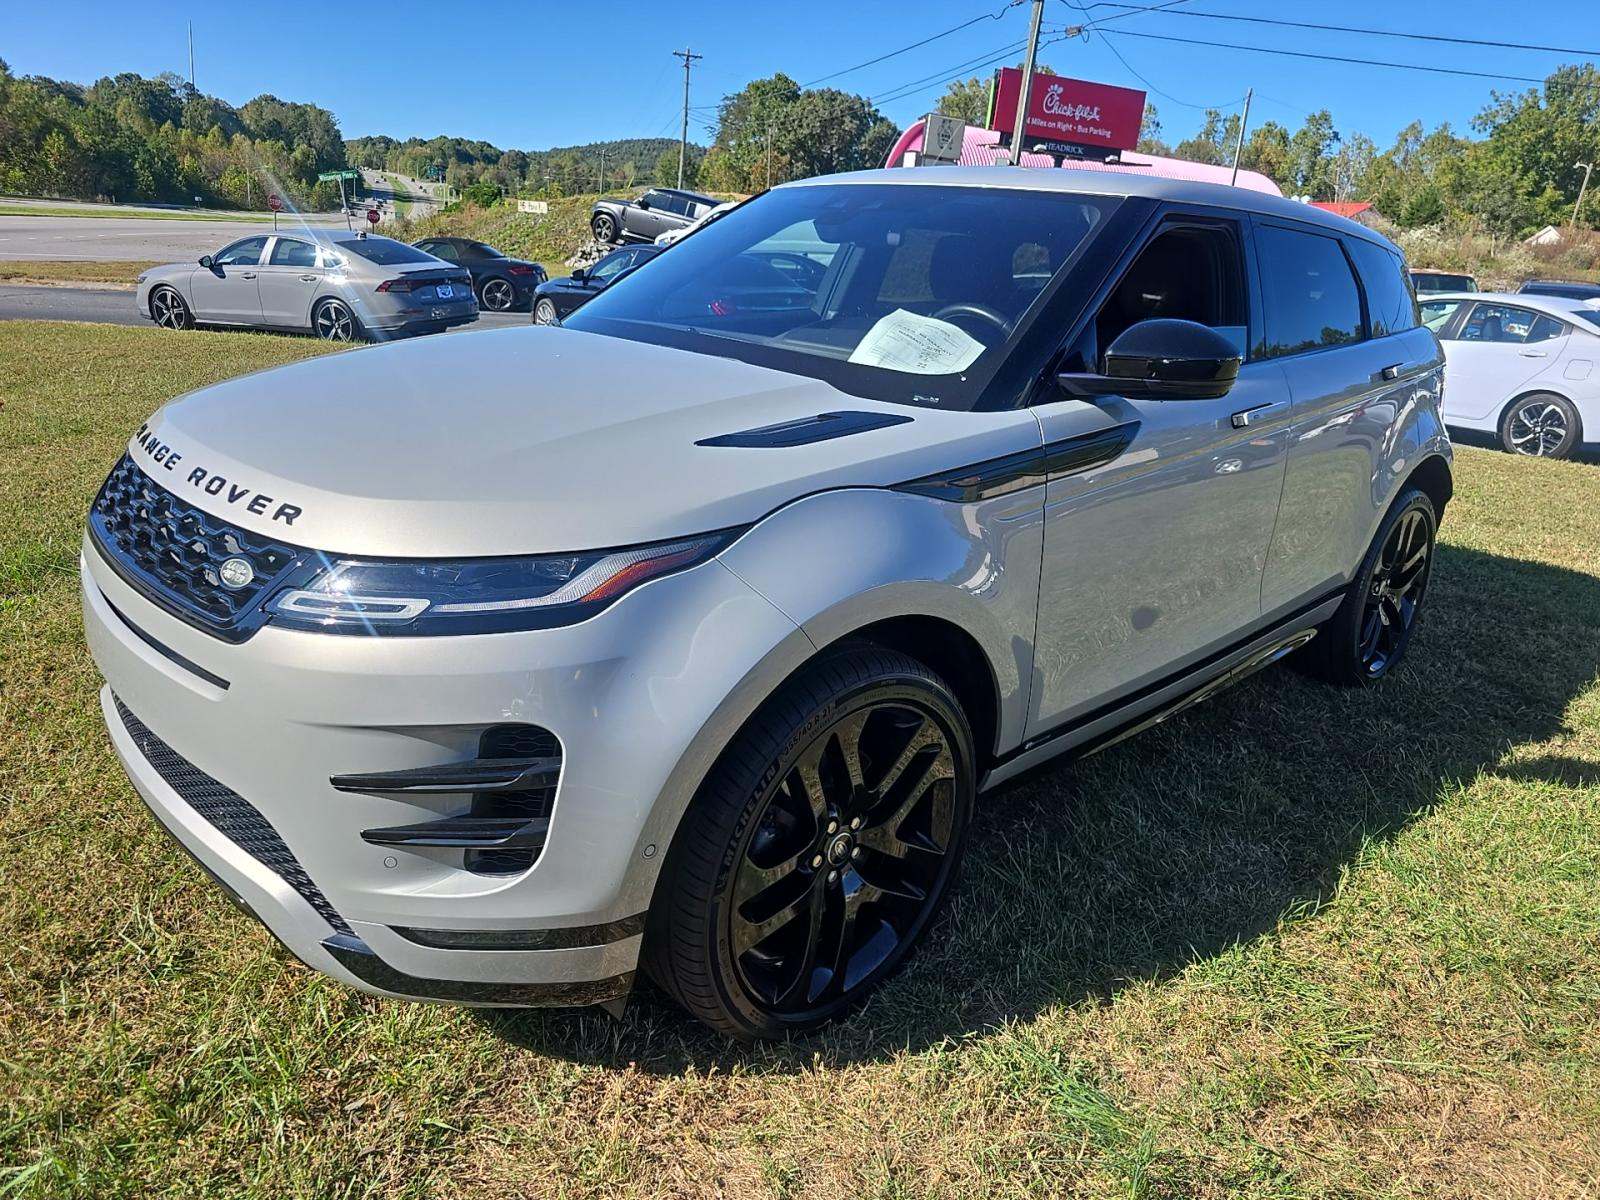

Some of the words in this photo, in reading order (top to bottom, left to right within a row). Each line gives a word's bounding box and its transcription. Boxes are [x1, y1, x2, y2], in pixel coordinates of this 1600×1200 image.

[1031, 117, 1046, 128] Miles
[1057, 121, 1073, 132] Right
[1077, 124, 1088, 133] Bus
[1089, 126, 1112, 138] Parking
[1045, 142, 1084, 155] HEADRICK
[136, 423, 182, 471] RANGE
[187, 466, 302, 526] ROVER
[724, 766, 777, 867] MICHELIN
